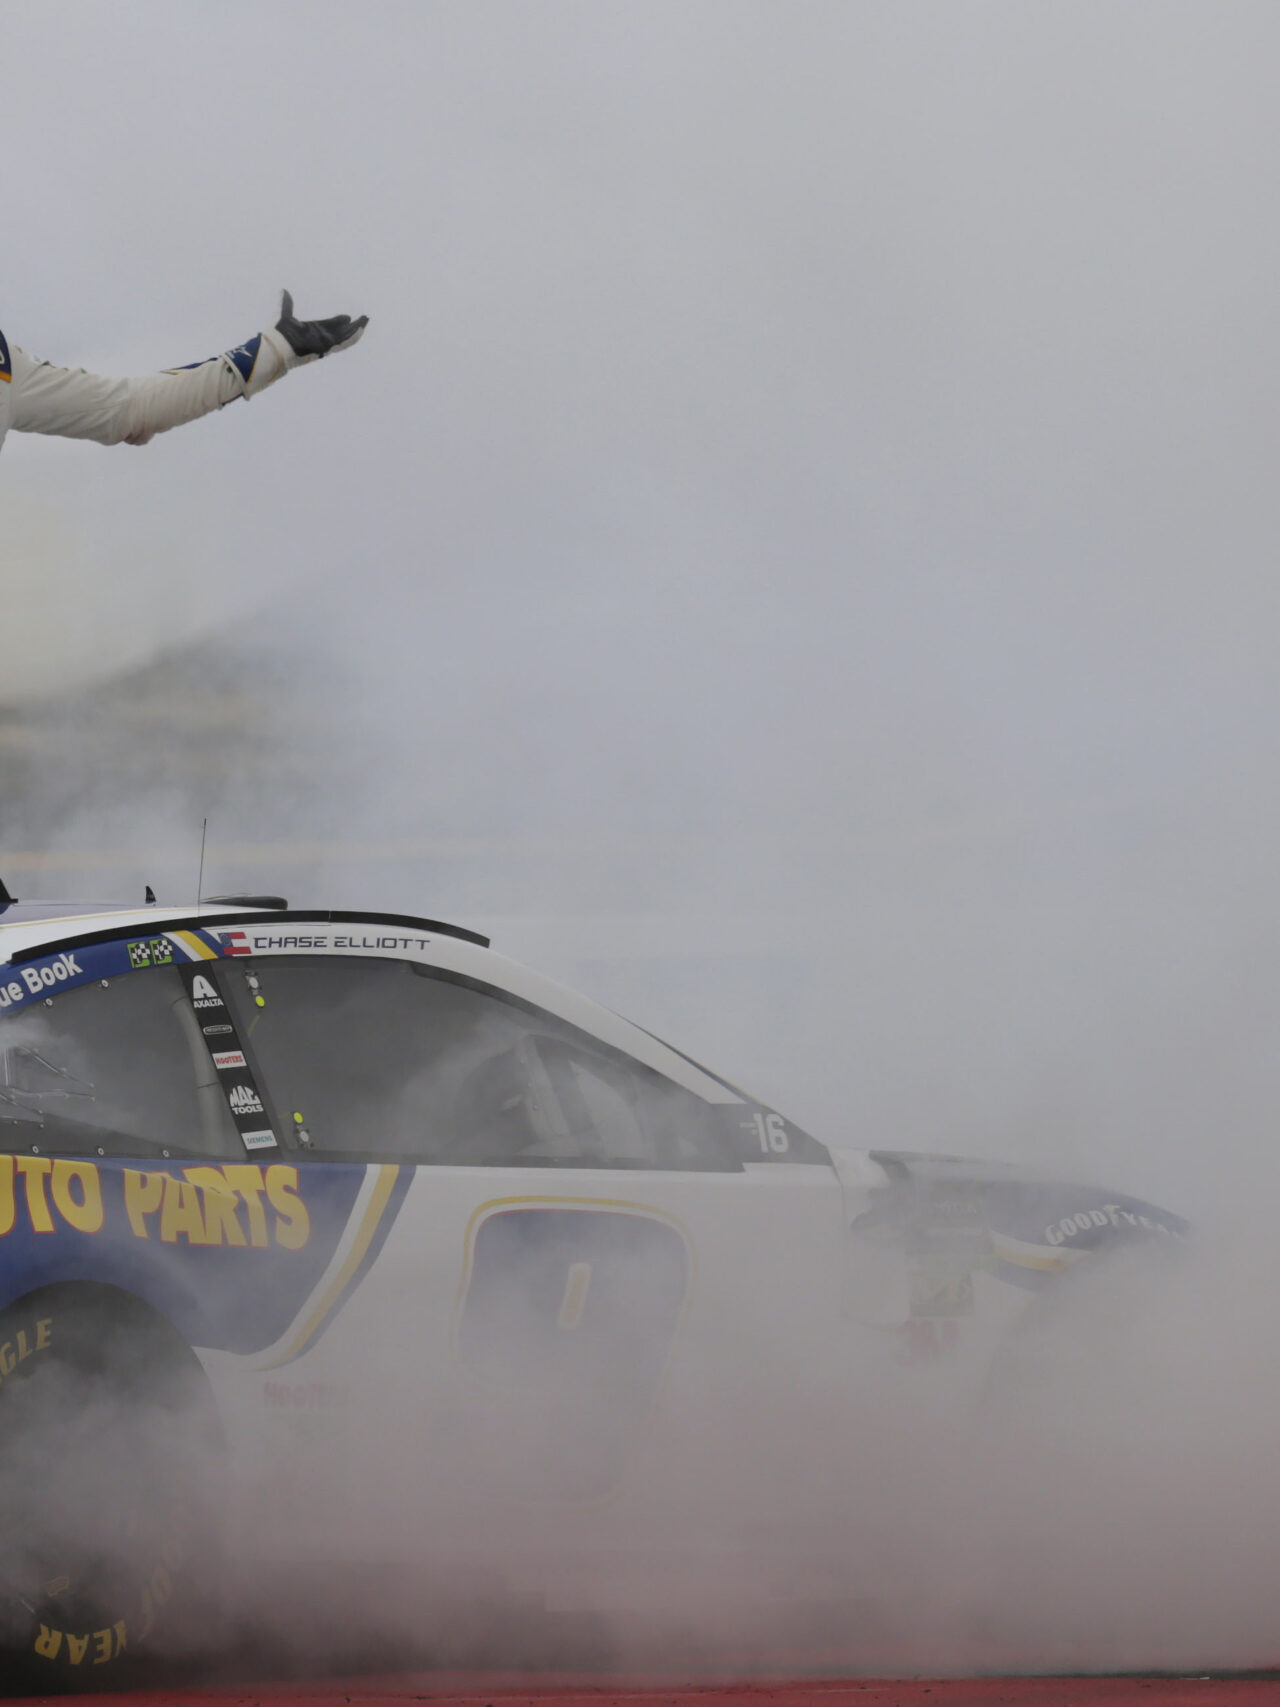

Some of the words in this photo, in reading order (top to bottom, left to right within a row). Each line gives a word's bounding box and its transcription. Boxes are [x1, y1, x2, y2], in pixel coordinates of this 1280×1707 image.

[253, 936, 328, 949] CHASE
[333, 936, 431, 951] ELLIOTT
[20, 953, 84, 994] Book
[194, 998, 224, 1009] AXALTA
[229, 1085, 261, 1107] MAC
[232, 1105, 264, 1115] TOOLS
[123, 1164, 311, 1250] PARTS
